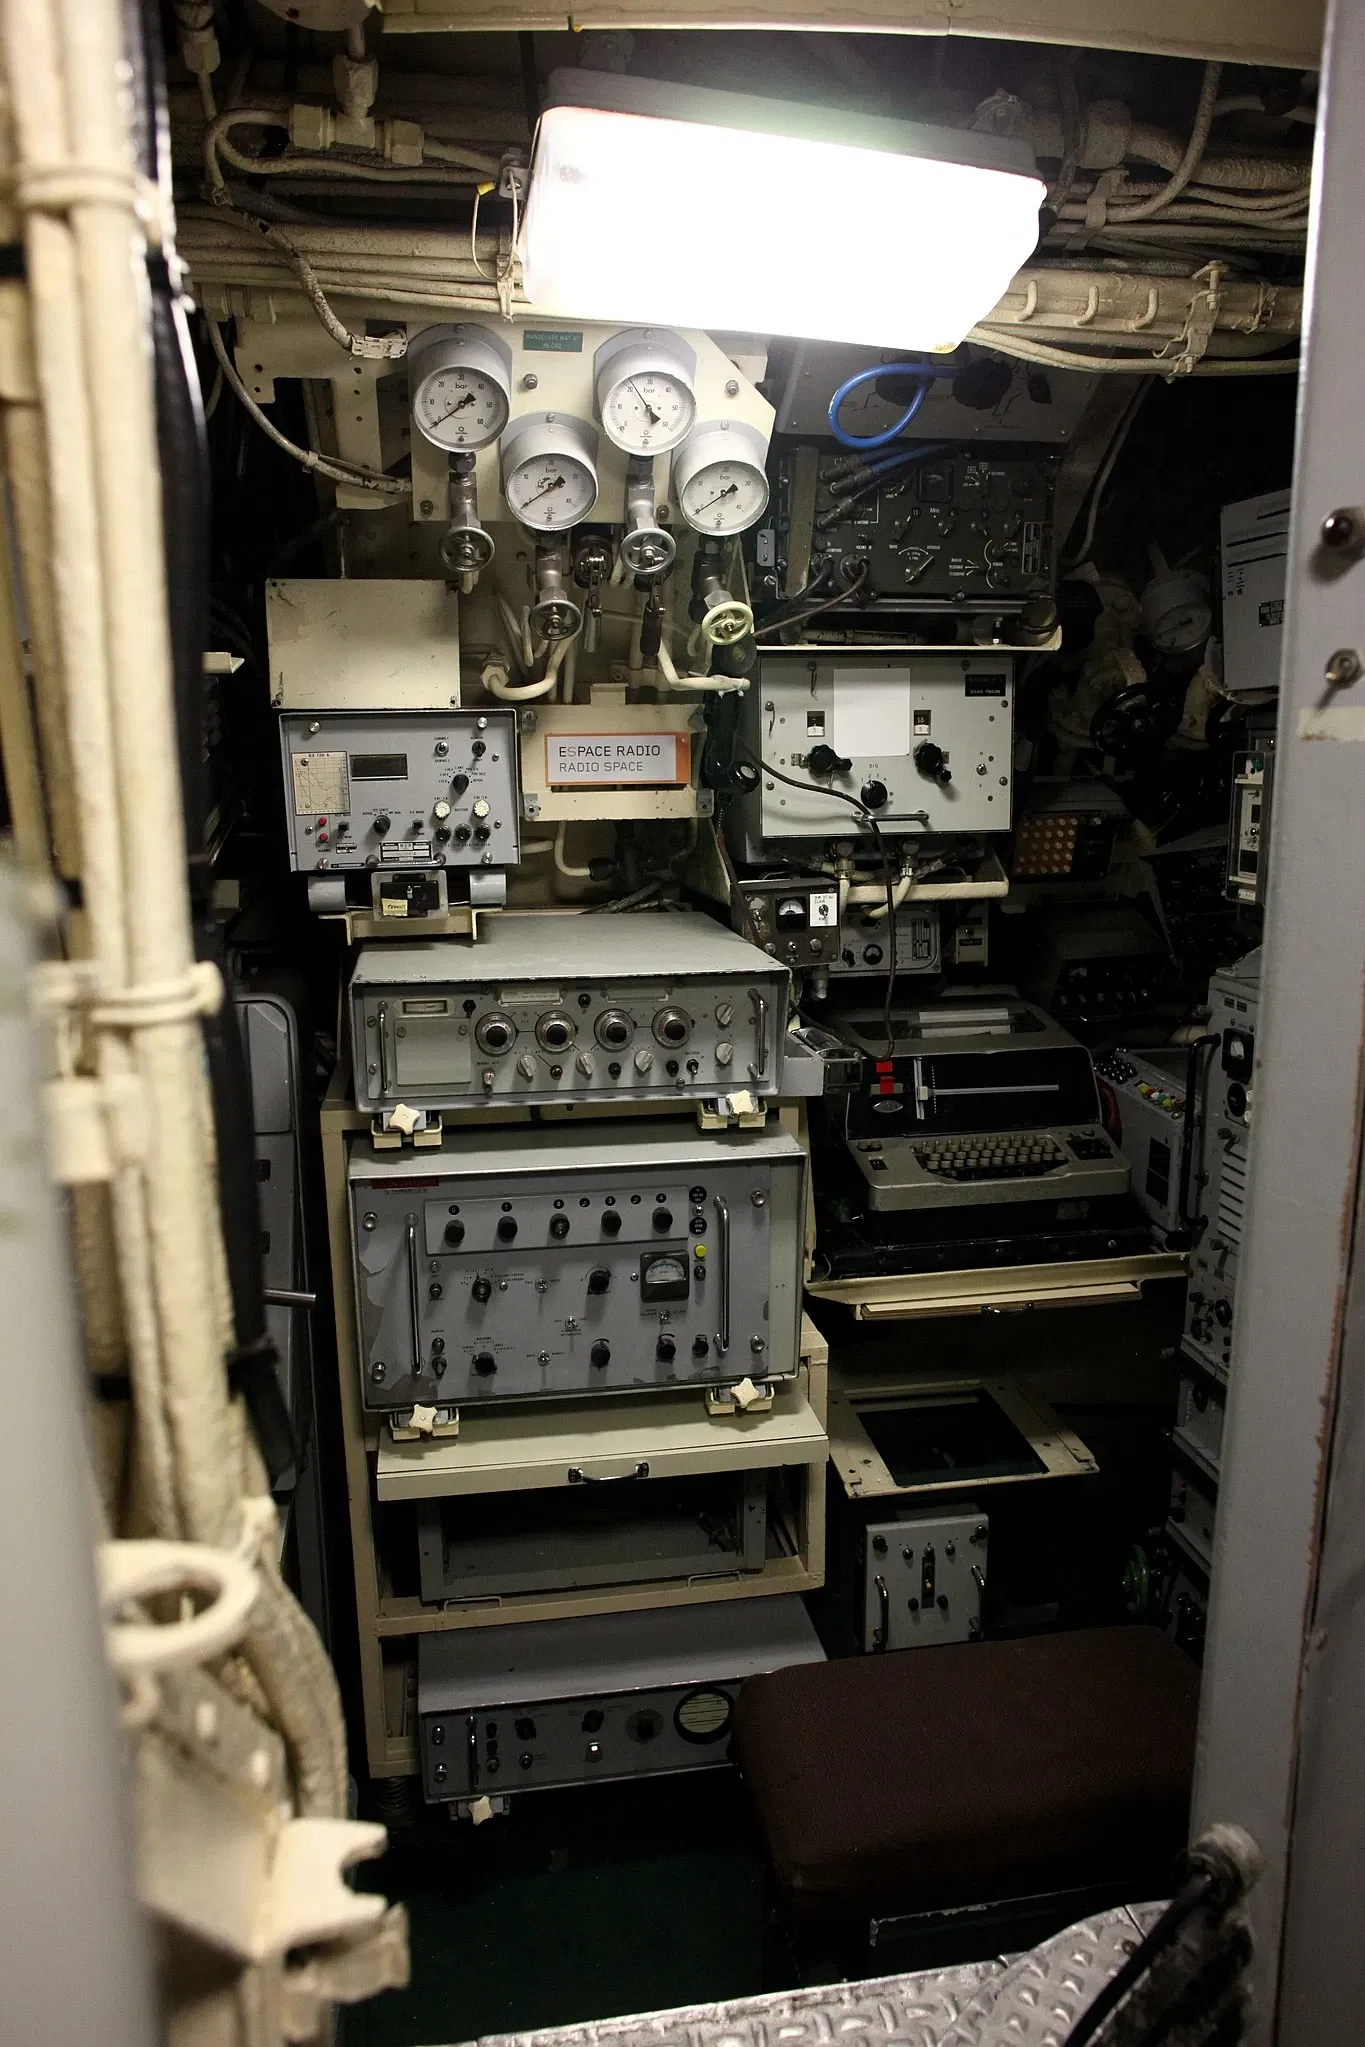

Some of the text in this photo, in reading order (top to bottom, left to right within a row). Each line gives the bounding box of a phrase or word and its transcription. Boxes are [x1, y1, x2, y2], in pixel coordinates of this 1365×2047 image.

[559, 745, 661, 757] ESPACE RADIO
[559, 761, 644, 773] RADIO SPACE
